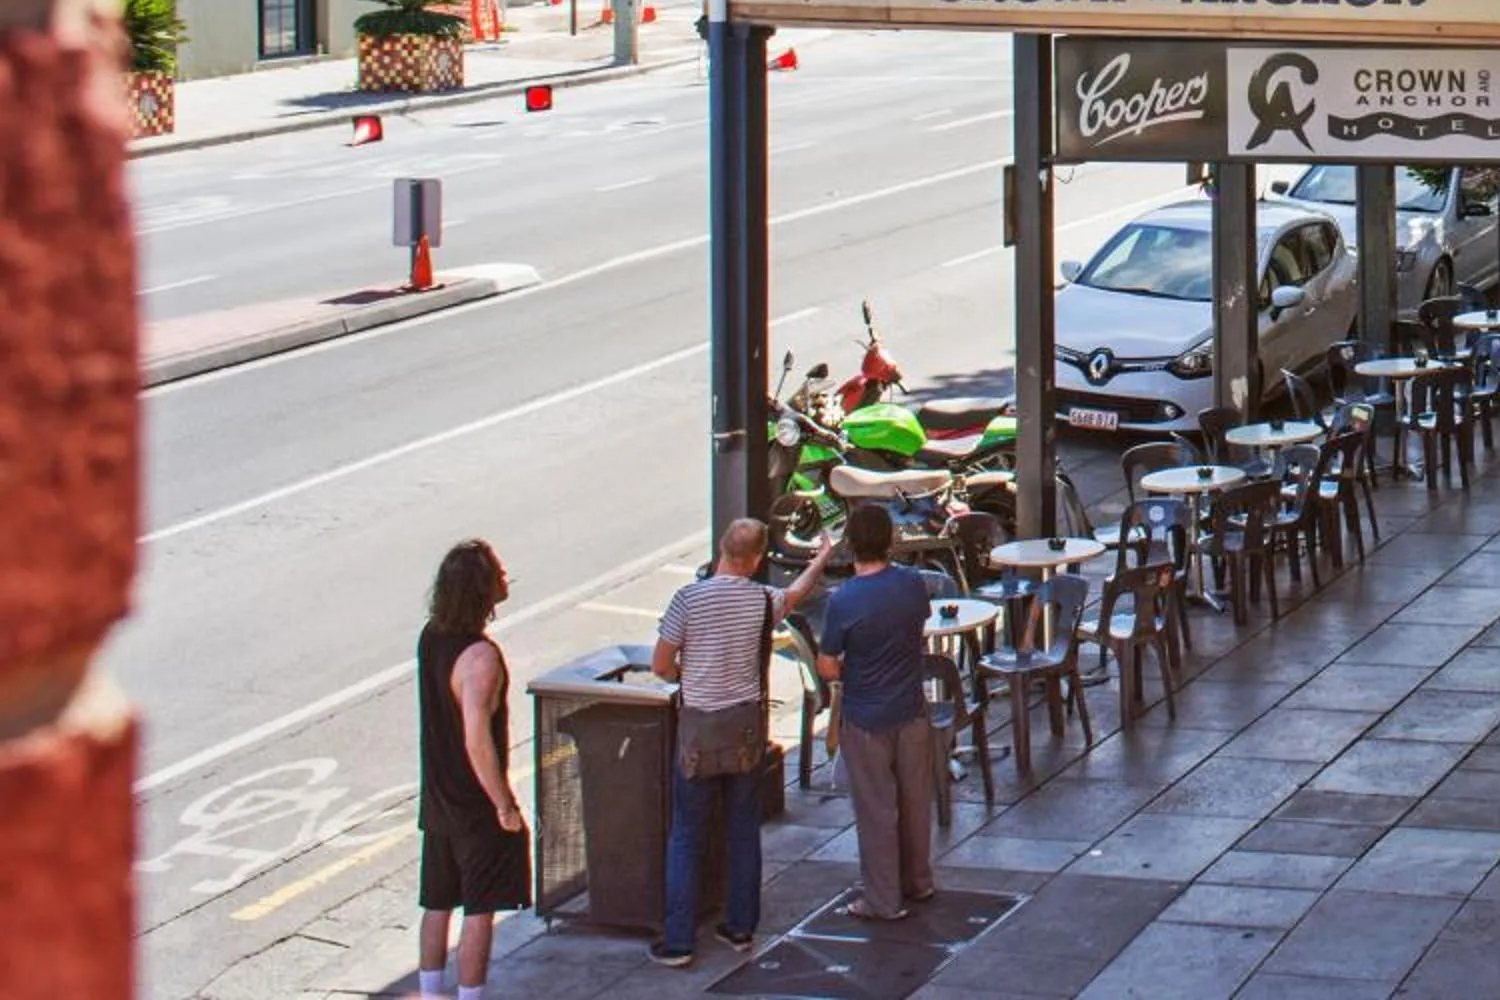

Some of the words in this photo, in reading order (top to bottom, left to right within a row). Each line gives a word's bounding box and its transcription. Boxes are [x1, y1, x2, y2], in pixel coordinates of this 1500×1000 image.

[1354, 69, 1466, 93] CROWN
[1477, 69, 1491, 93] AND
[1076, 53, 1209, 137] Coopers
[1356, 95, 1490, 107] ANCHOR
[1343, 117, 1500, 137] HOTEL
